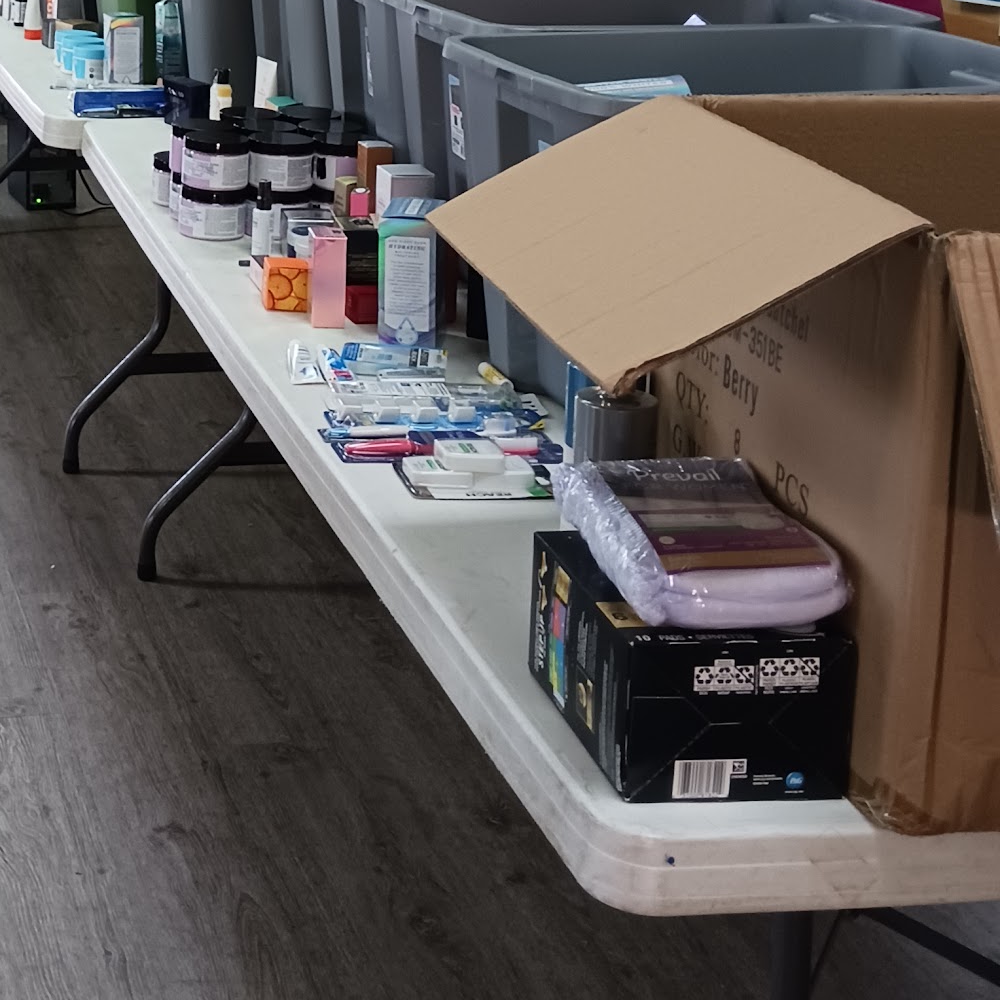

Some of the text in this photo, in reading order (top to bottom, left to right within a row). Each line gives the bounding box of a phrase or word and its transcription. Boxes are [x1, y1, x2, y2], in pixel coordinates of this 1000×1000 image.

[767, 305, 810, 342] atchel
[723, 353, 759, 416] Berry
[675, 371, 810, 516] QTY: 8 PCS
[627, 468, 721, 482] Prevail
[635, 634, 651, 642] 10
